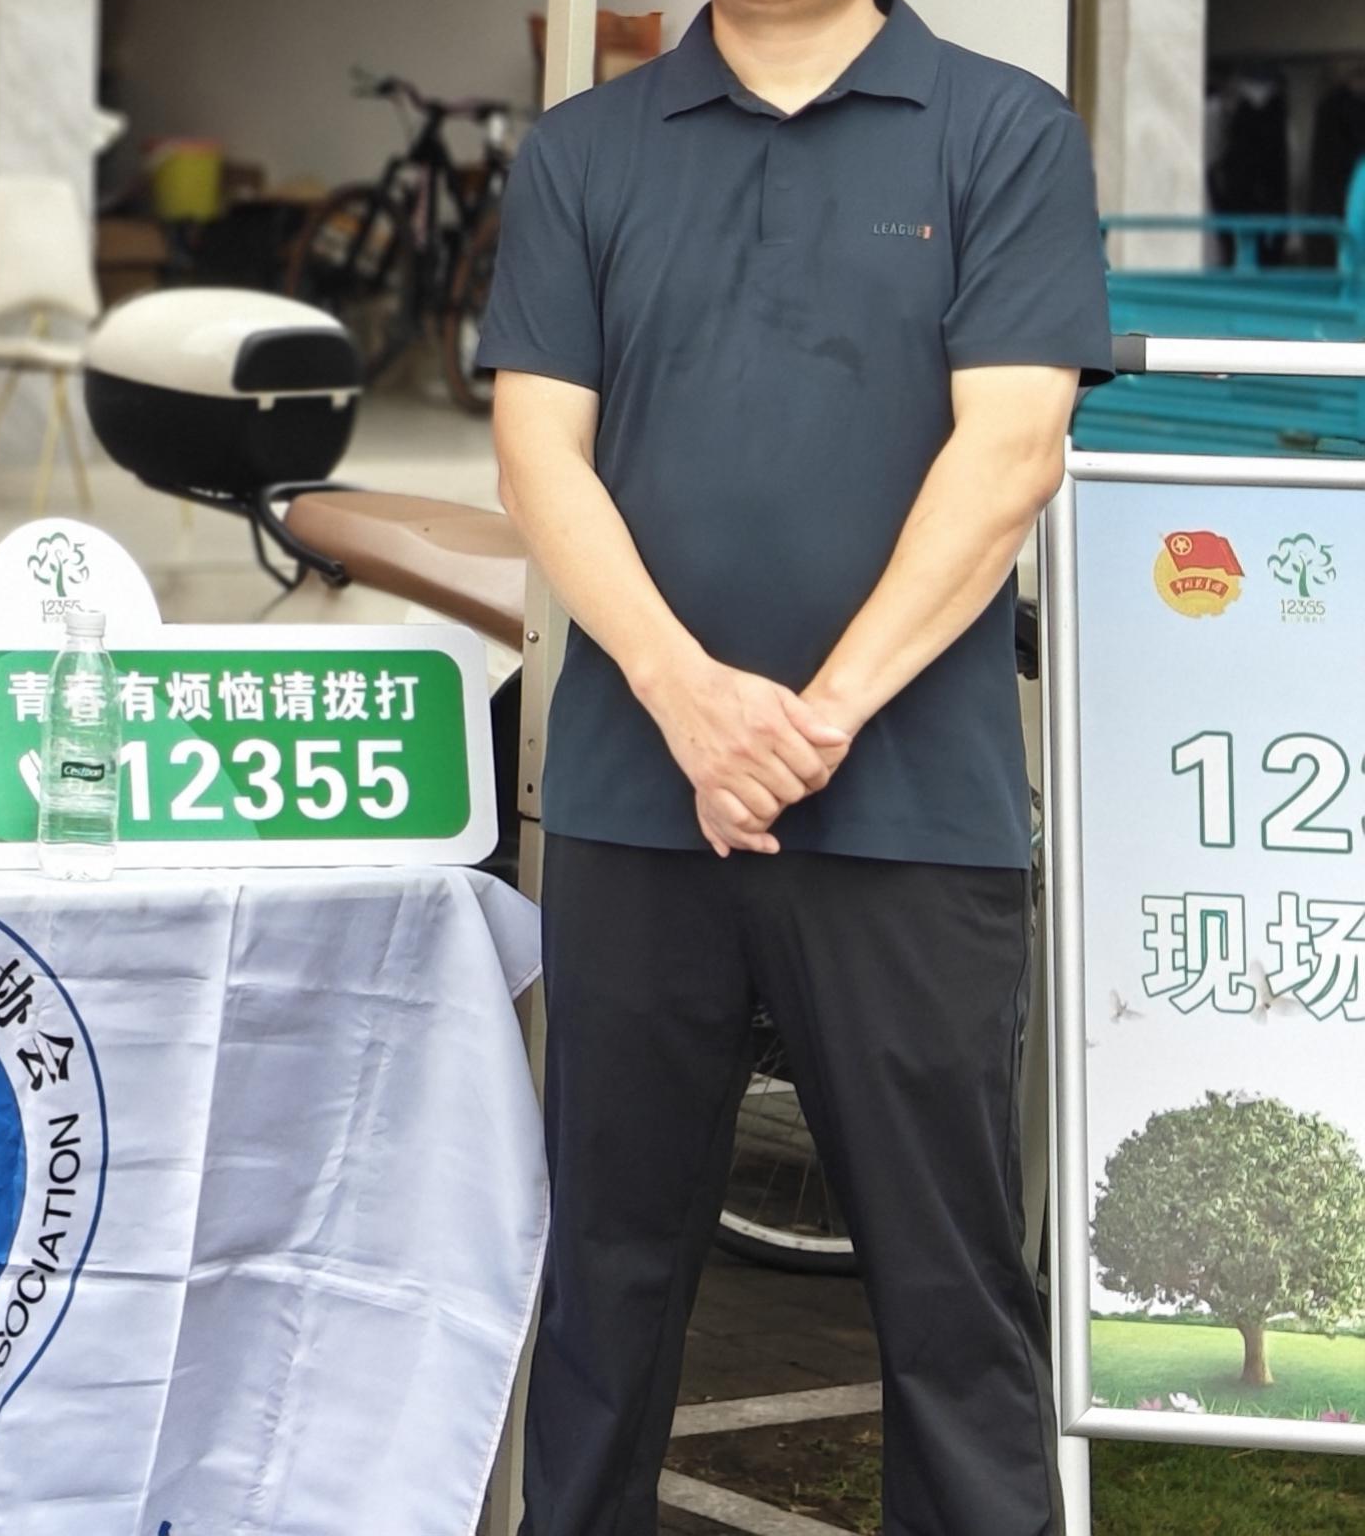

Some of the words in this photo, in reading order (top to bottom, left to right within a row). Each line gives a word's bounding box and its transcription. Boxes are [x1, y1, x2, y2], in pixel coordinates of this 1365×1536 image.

[1280, 599, 1326, 615] 12355
[7, 669, 418, 723] 青春有烦恼请拨打
[118, 739, 409, 820] 12355
[1172, 730, 1365, 853] 12
